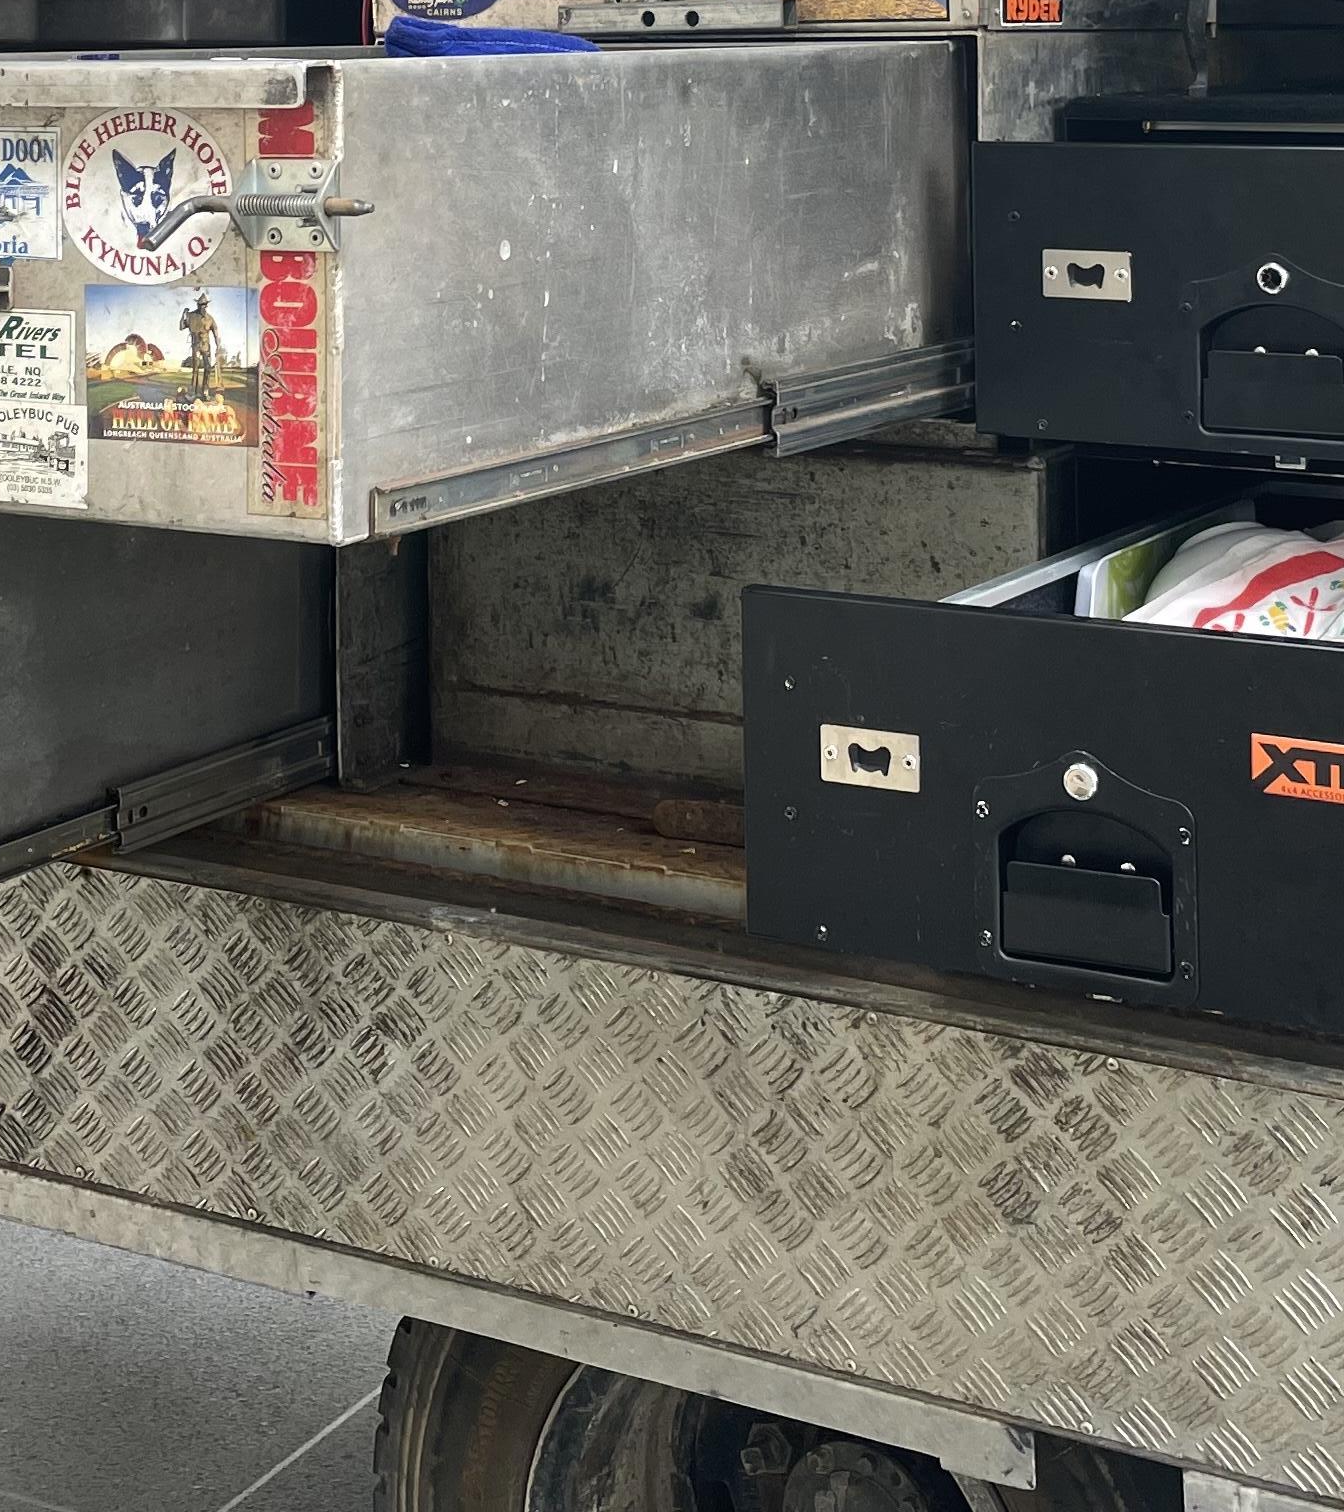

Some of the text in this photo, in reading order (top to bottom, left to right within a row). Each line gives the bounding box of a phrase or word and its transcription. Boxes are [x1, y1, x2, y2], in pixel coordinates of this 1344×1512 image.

[1, 138, 55, 162] DOON
[65, 111, 228, 210] BLUE HEELER HOTE
[258, 104, 319, 507] MBOURNE
[12, 377, 41, 387] 4222
[25, 367, 41, 376] NQ
[56, 416, 80, 436] PUB
[112, 409, 182, 430] HALL OF
[260, 328, 288, 503] Australia
[104, 430, 146, 438] LONGREACH
[149, 431, 199, 440] QUEENSLAND
